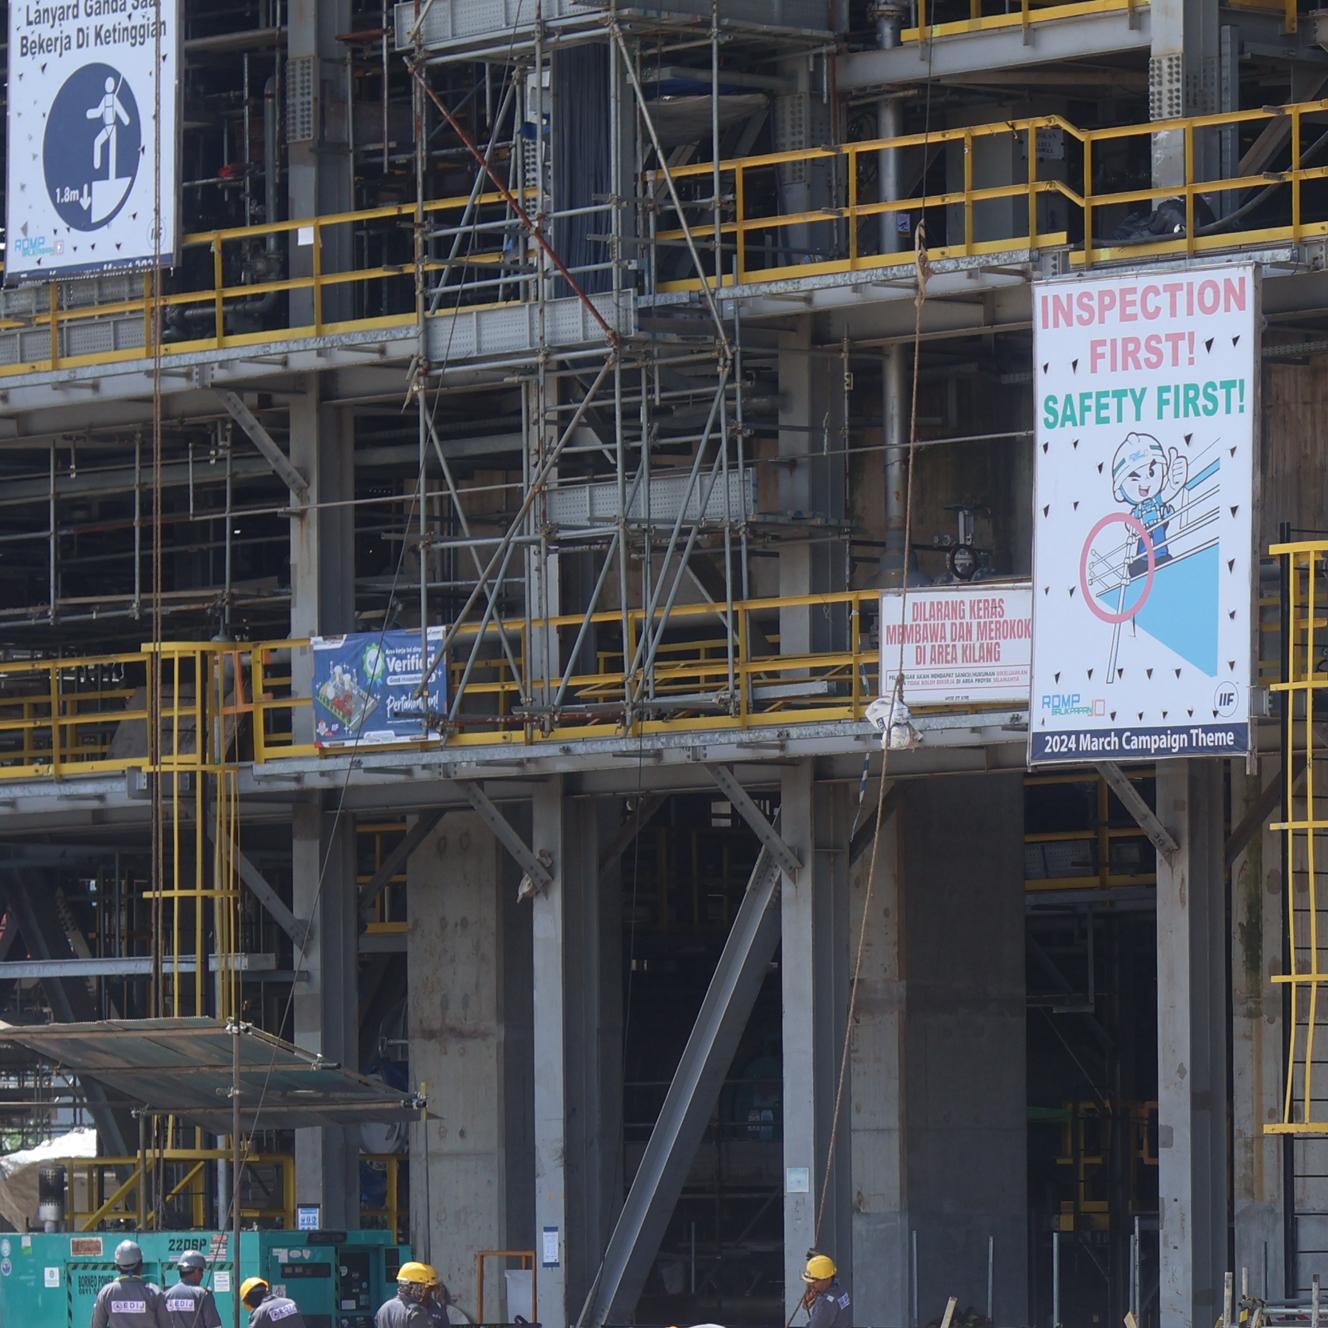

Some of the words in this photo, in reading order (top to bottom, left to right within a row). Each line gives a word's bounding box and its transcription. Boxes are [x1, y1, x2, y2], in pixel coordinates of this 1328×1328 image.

[26, 0, 79, 28] Lanyard
[84, 0, 127, 17] Ganda
[20, 30, 72, 57] Bekerja
[76, 27, 90, 49] Di
[55, 186, 80, 203] 1.8m
[1041, 276, 1246, 330] INSPECTION
[1090, 331, 1195, 374] FIRST!
[1043, 386, 1147, 430] SAFETY
[1156, 378, 1245, 420] FIRST!
[912, 600, 966, 622] DILARANG
[969, 598, 1005, 620] KERAS
[886, 623, 947, 645] MEMBAWA
[950, 621, 973, 642] DAN
[976, 618, 1032, 641] MEROKOK
[915, 645, 926, 665] DI
[930, 644, 958, 665] AREA
[961, 642, 1001, 664] KILANG
[1044, 734, 1077, 753] 2024
[1079, 731, 1119, 751] March
[1122, 729, 1188, 753] Campaign
[1190, 728, 1235, 747] Theme
